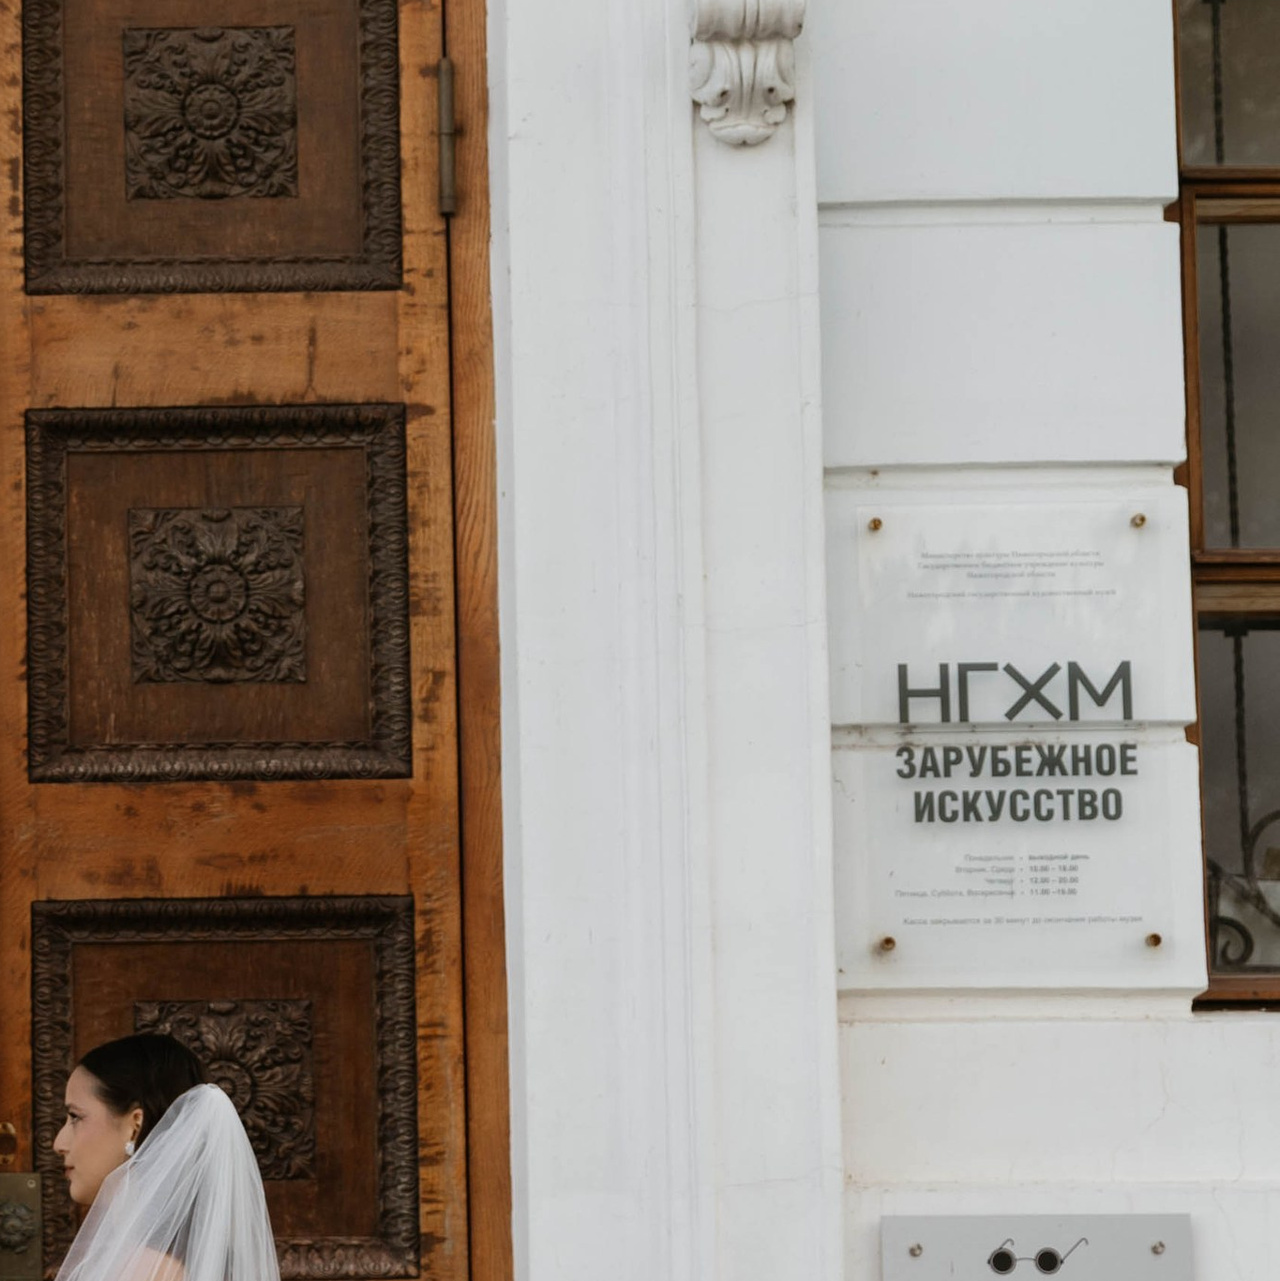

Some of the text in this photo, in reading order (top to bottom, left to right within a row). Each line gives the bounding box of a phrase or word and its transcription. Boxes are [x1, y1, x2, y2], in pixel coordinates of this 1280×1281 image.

[898, 660, 1133, 723] НГХМ
[895, 743, 1138, 779] ЗАРУБЕЖНОЕ
[914, 788, 1124, 823] ИСКУССТВО
